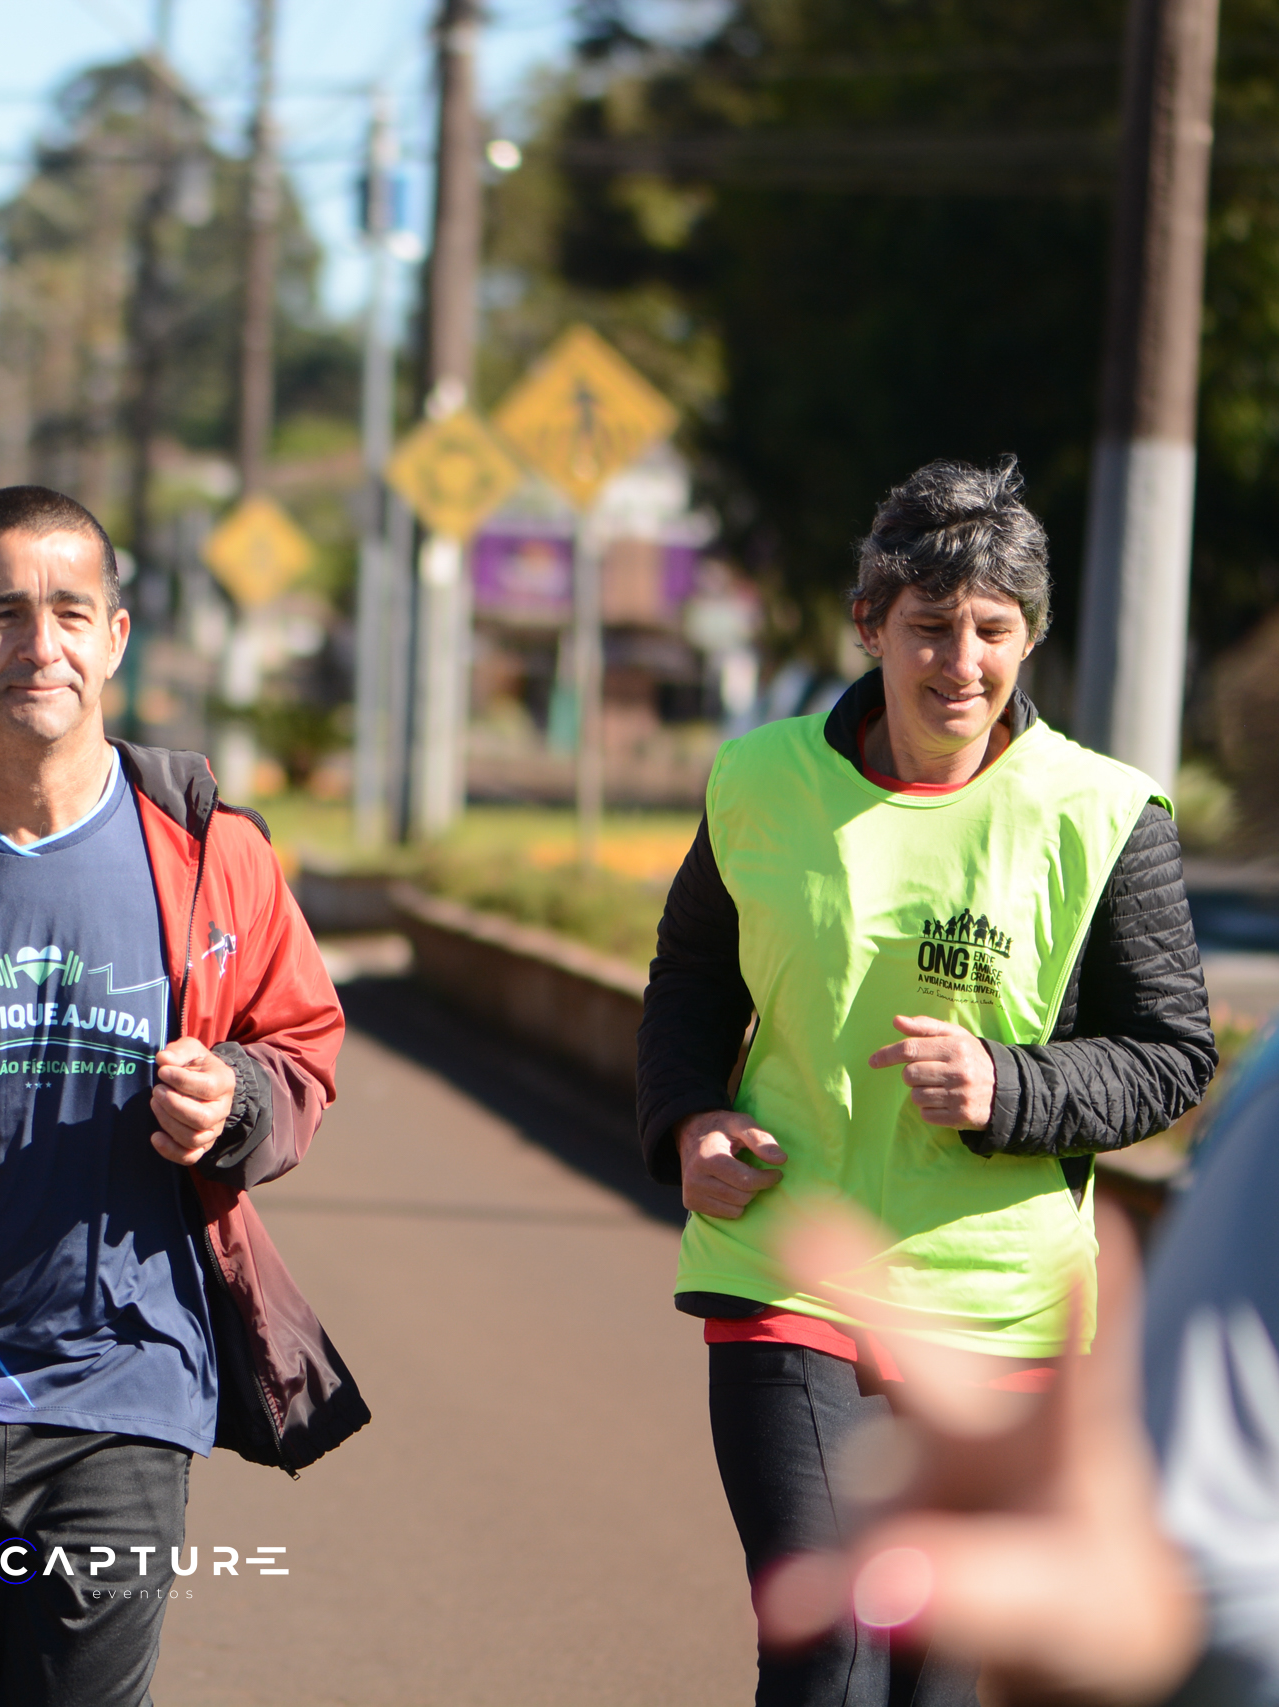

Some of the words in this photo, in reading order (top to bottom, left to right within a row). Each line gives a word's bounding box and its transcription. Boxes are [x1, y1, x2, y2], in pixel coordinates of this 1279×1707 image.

[918, 941, 970, 980] ONG
[973, 951, 996, 964] ENTE
[918, 973, 923, 982] A
[924, 974, 939, 986] VIDA
[939, 978, 953, 990] FICA
[953, 982, 973, 993] MAIS
[973, 984, 1001, 999] DIVERT
[61, 1003, 150, 1044] AJUDA
[22, 1058, 70, 1075] FÍSICA
[71, 1060, 94, 1074] EM
[96, 1060, 136, 1080] AÇÃO
